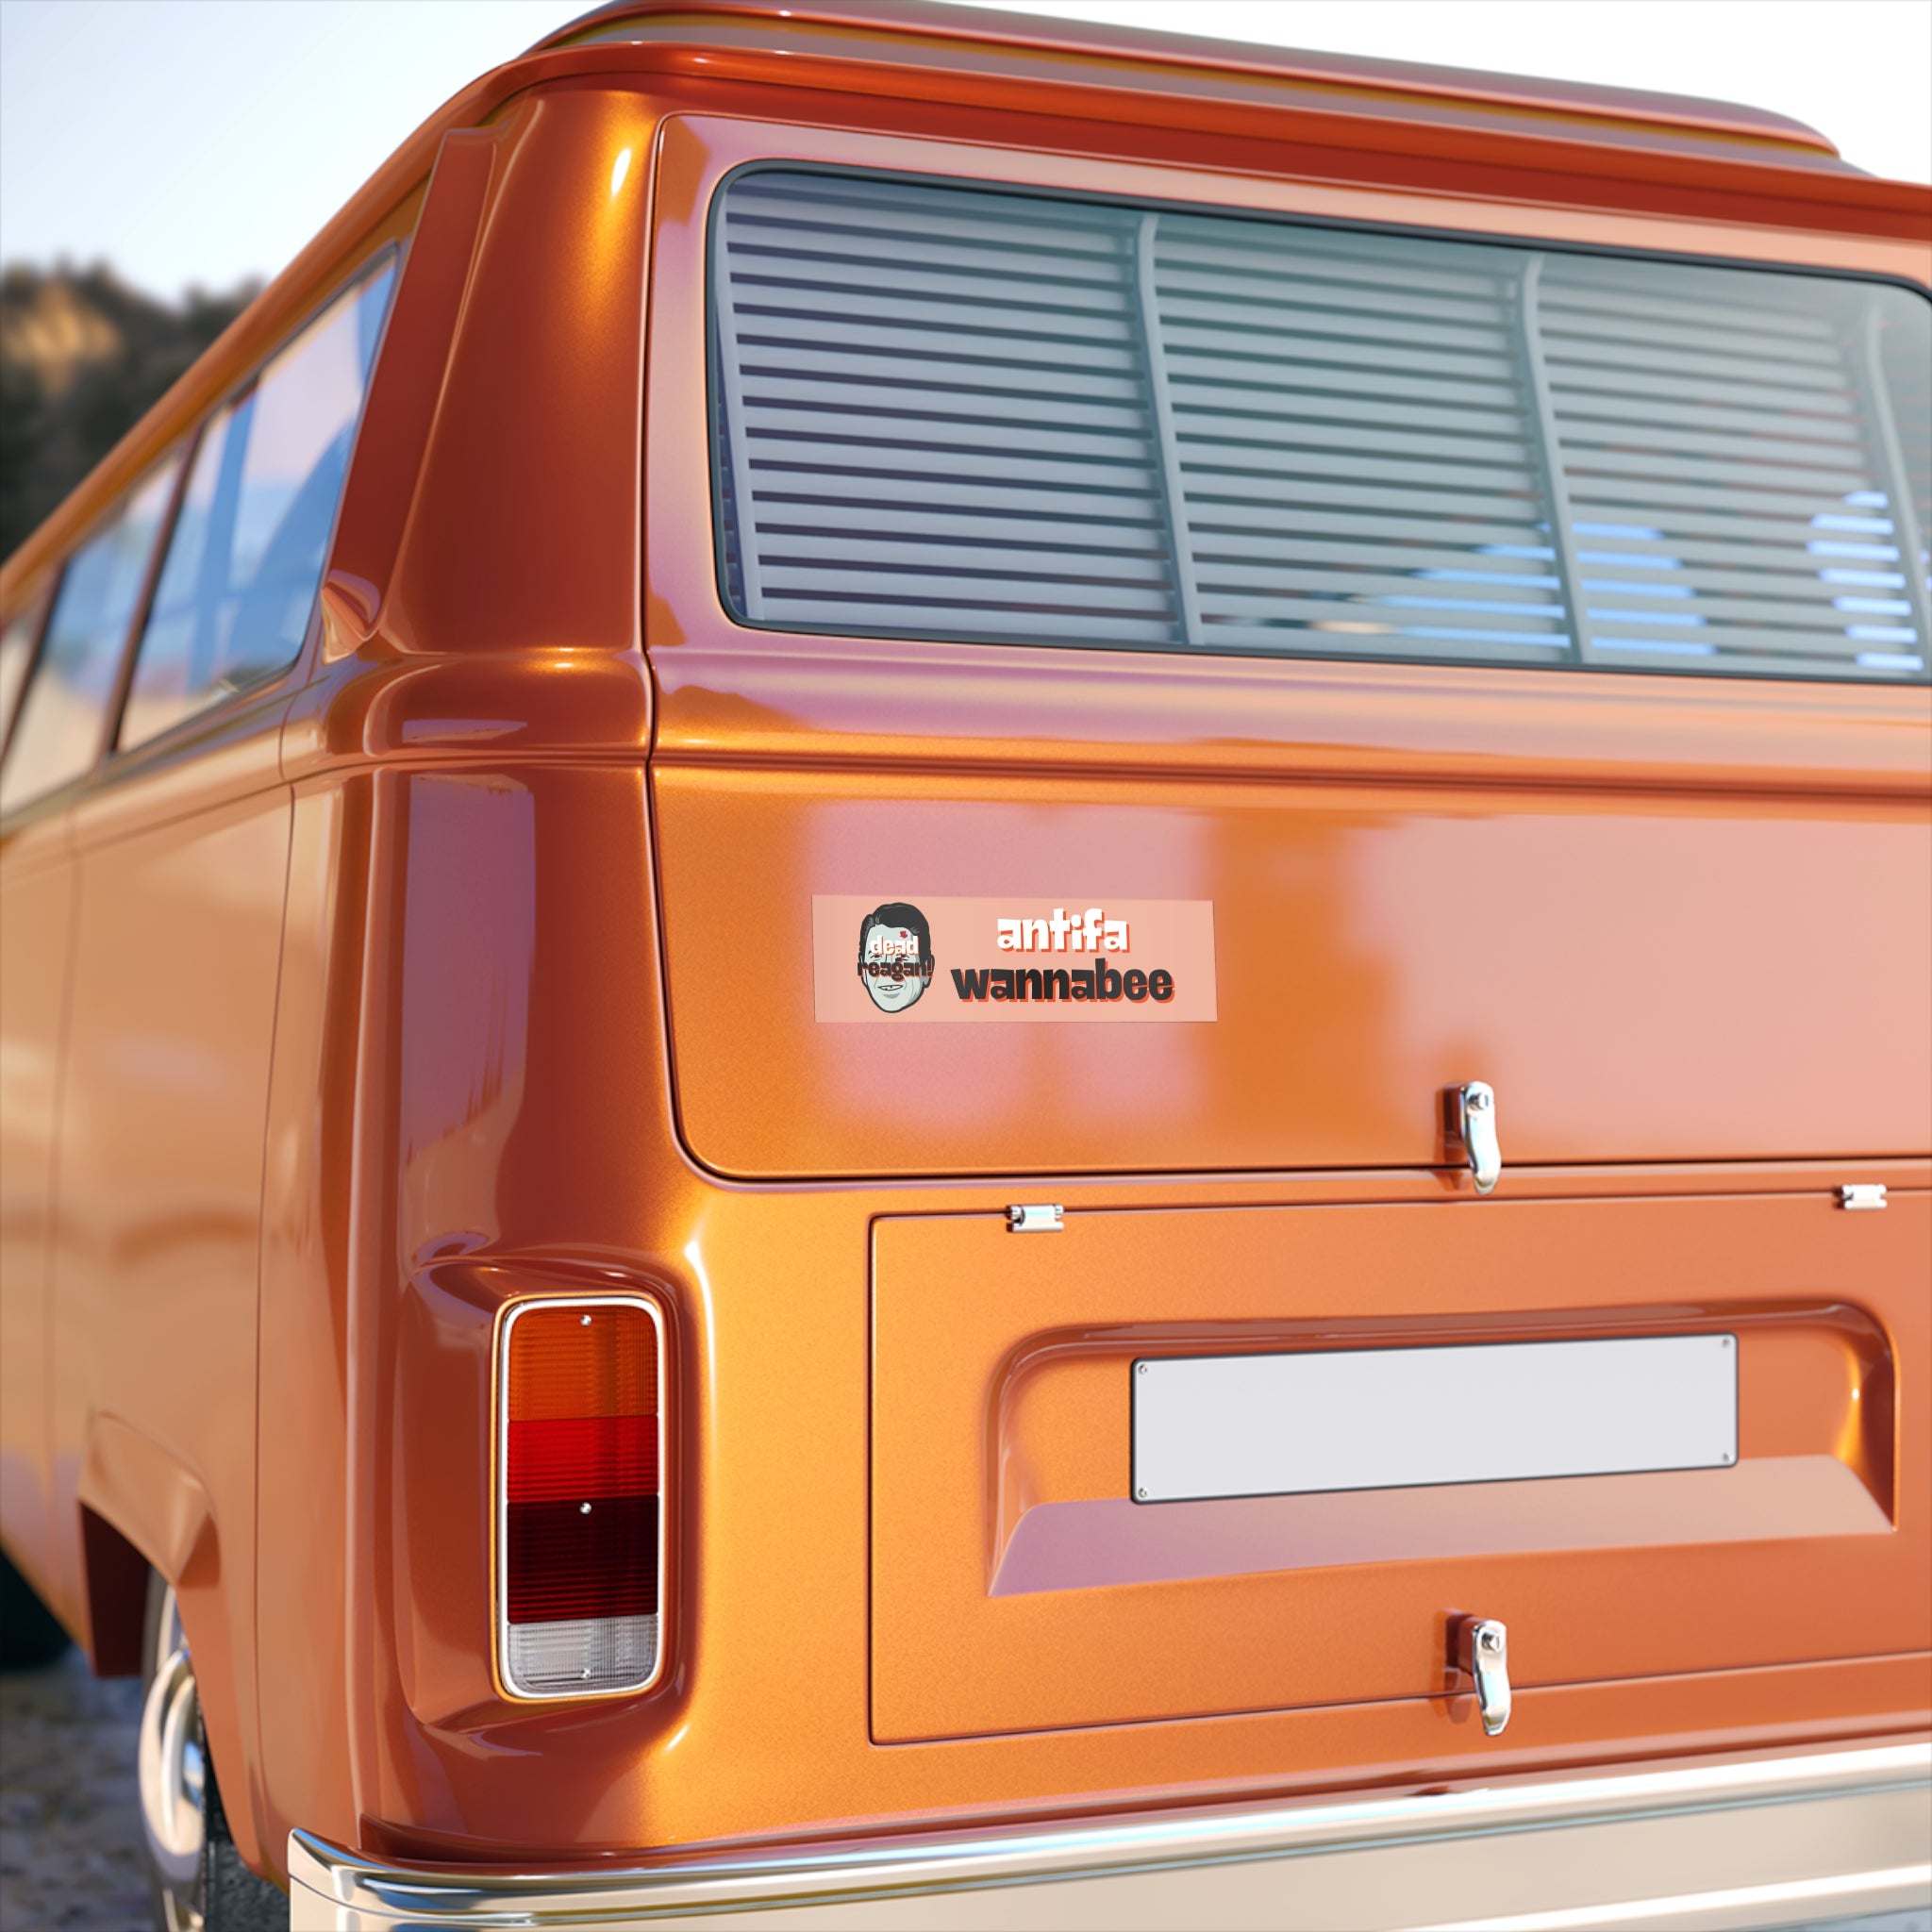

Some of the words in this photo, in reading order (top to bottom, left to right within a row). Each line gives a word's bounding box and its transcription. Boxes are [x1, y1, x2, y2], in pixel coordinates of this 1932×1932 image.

[870, 935, 919, 955] dead
[996, 908, 1130, 953] antifa
[857, 958, 934, 981] reagan!
[950, 958, 1174, 1003] wannabee
